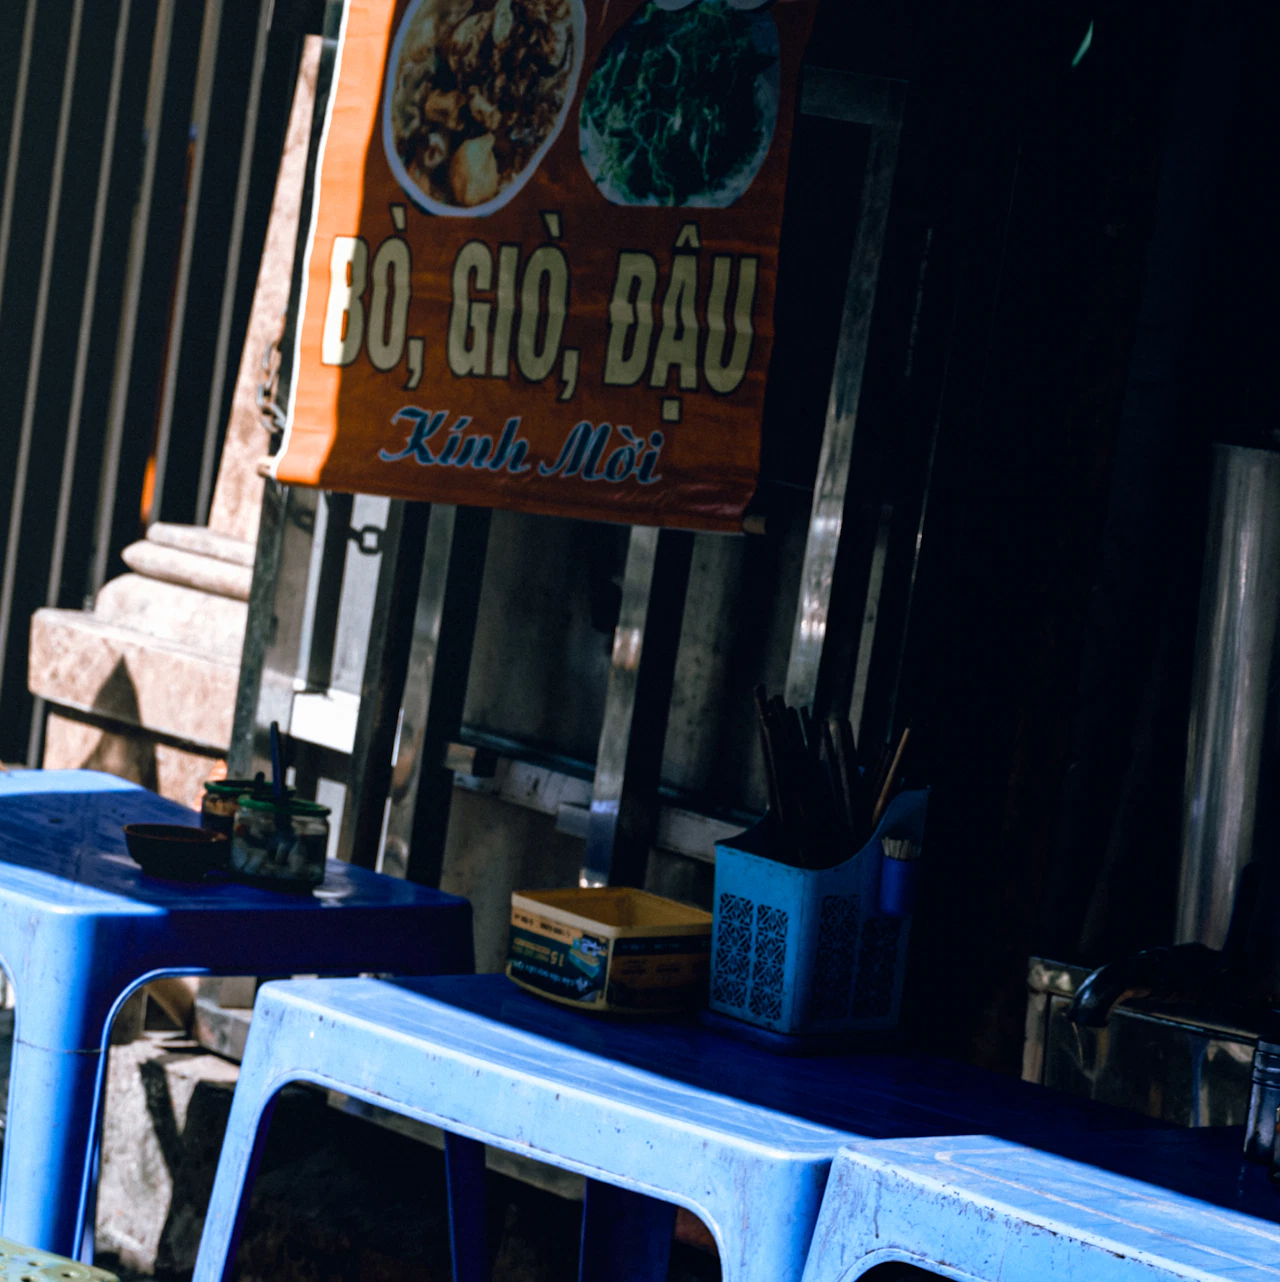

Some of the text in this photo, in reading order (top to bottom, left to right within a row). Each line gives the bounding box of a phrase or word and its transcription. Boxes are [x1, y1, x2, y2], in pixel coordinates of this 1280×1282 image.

[322, 203, 759, 423] BÒ, GIÒ, ĐẬU
[378, 405, 666, 486] Kính Mời
